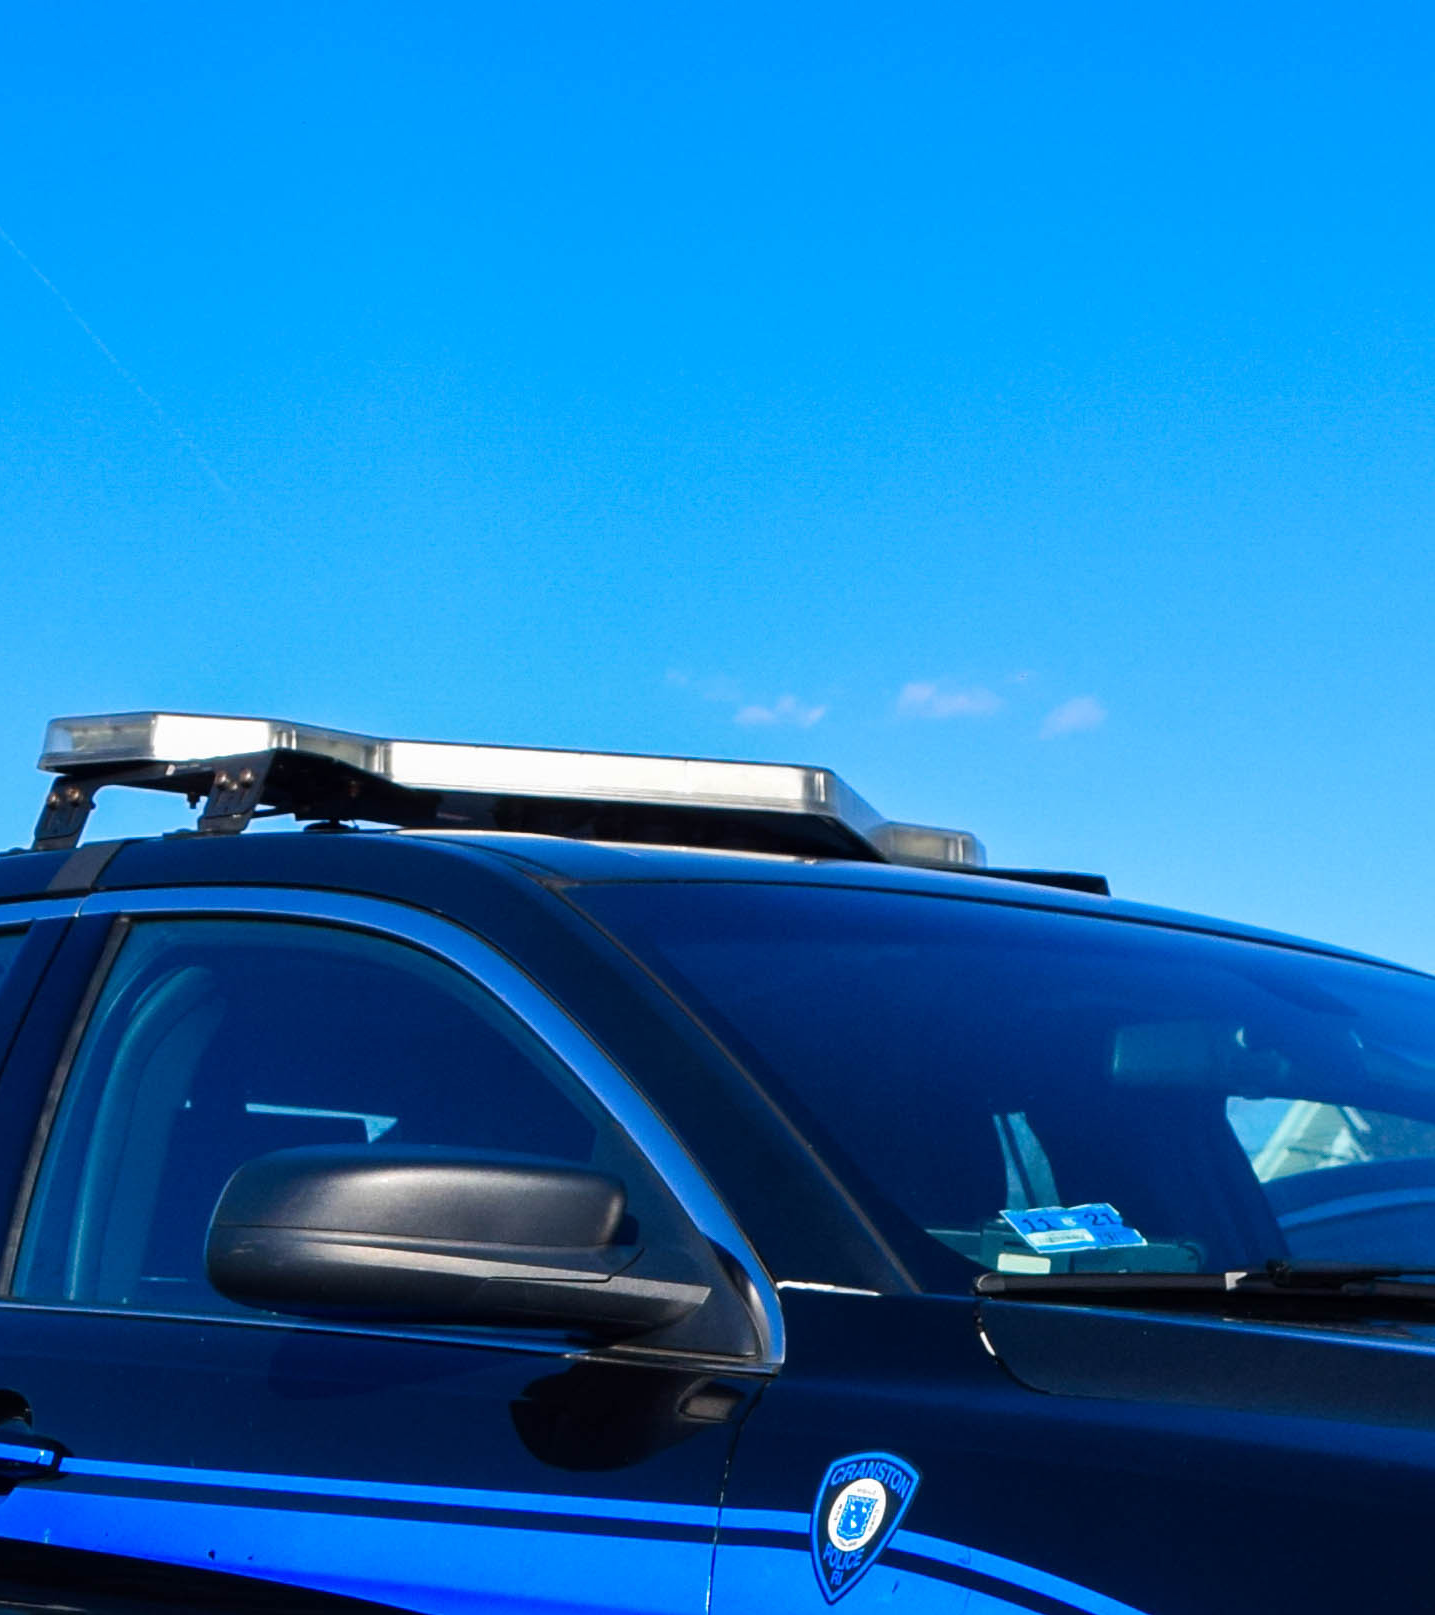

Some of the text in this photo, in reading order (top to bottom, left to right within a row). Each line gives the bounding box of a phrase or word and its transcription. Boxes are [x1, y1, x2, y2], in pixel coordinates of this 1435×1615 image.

[830, 1461, 911, 1499] CRANSTON
[822, 1541, 865, 1571] POLICE
[830, 1571, 843, 1585] RI
